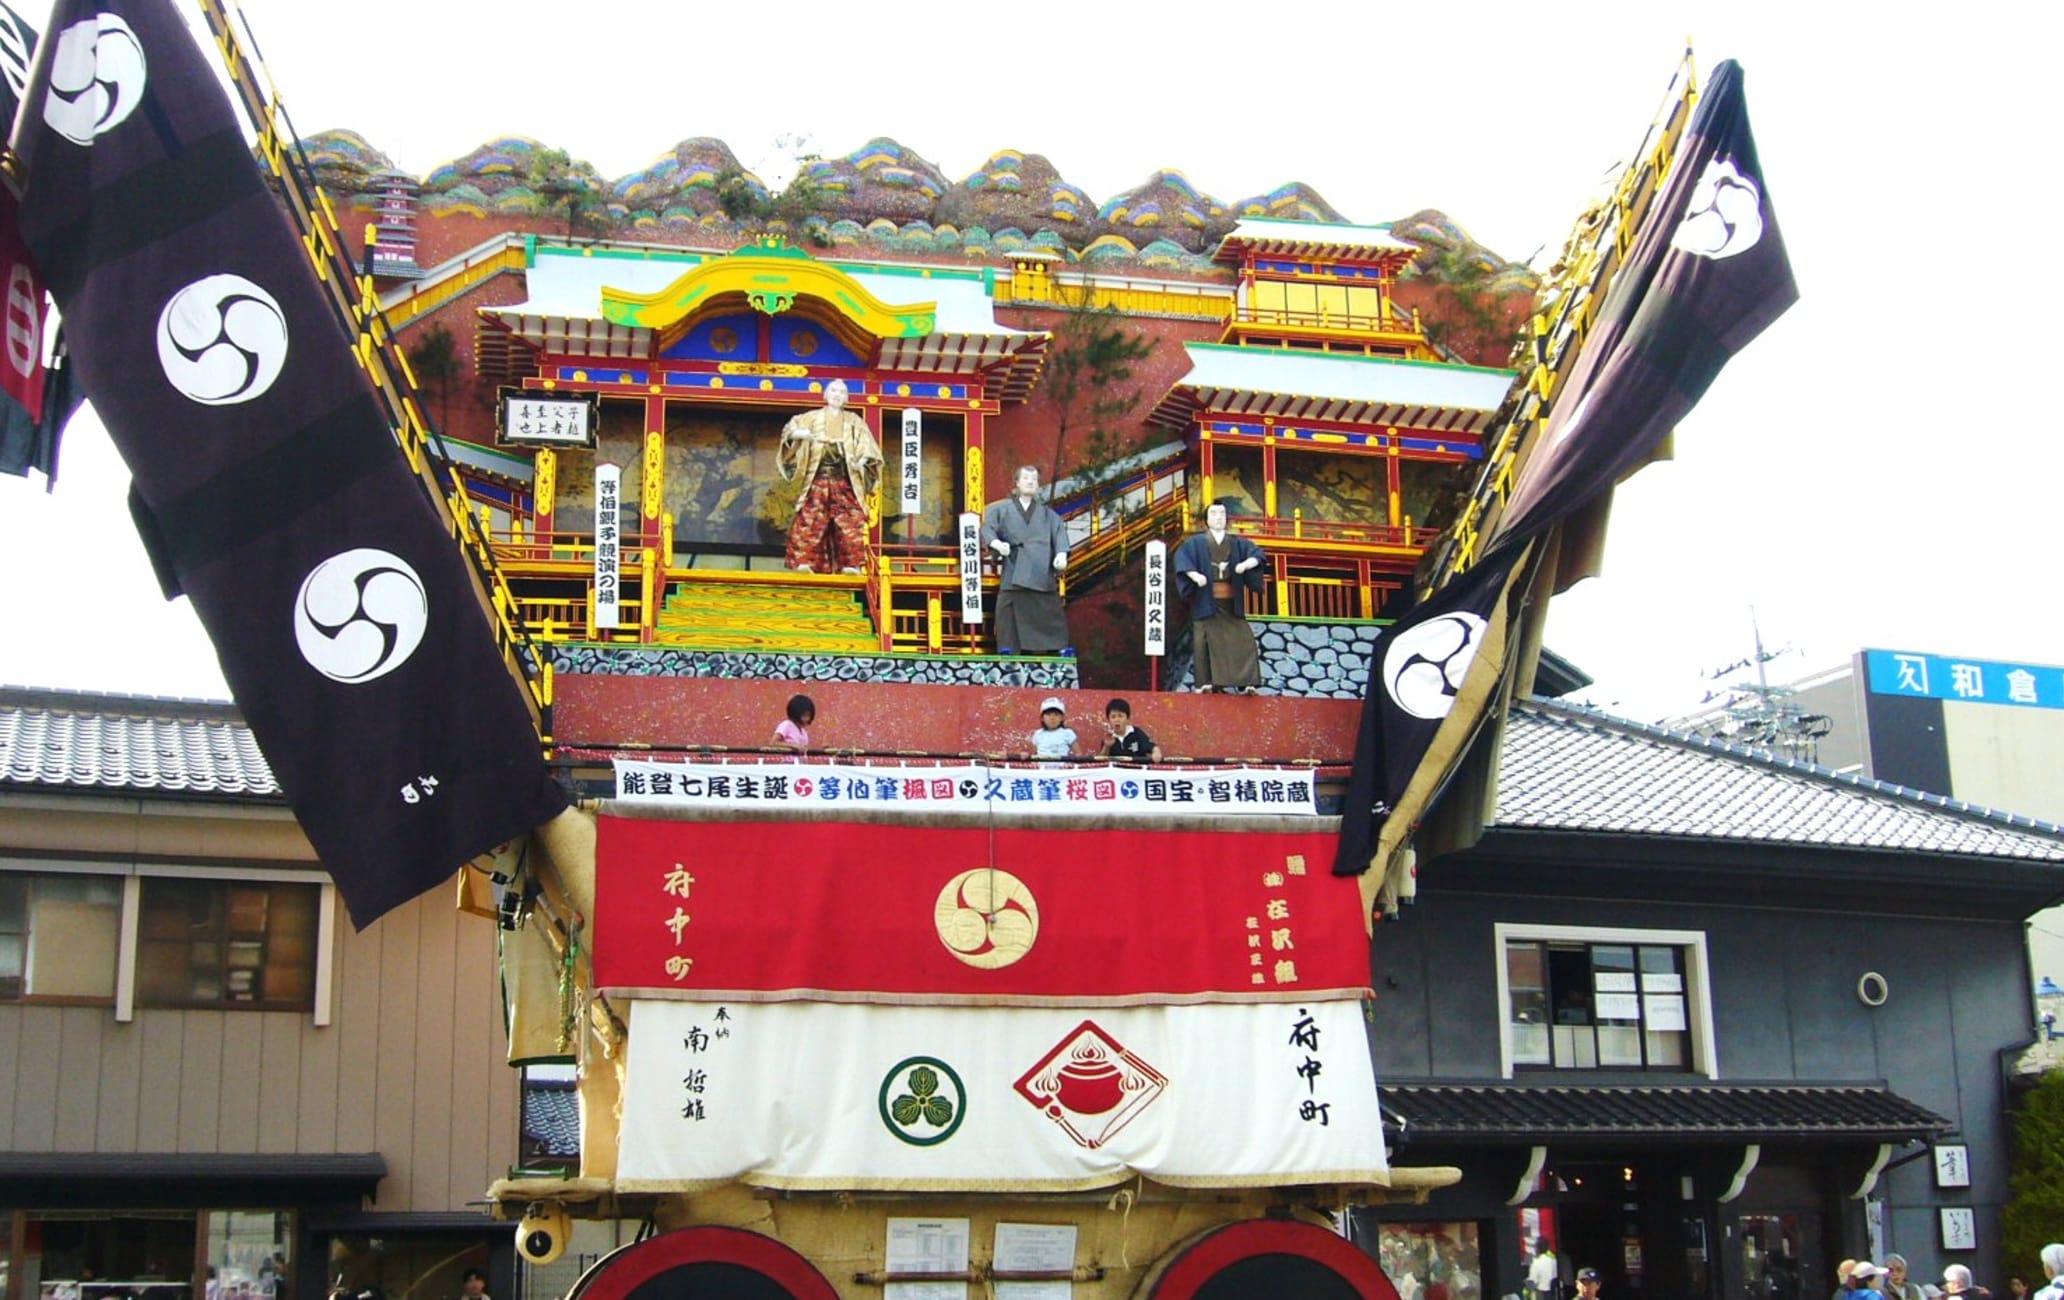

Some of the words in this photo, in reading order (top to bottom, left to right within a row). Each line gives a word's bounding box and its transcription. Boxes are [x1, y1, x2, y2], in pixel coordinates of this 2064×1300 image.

[903, 419, 919, 502] 豊臣秀吉
[597, 479, 617, 605] 等伯親子競演の場
[963, 524, 980, 610] 長谷川等伯
[1148, 554, 1163, 642] 長谷川久蔵
[1952, 664, 2064, 705] 和倉
[622, 772, 789, 800] 能登七尾生誕
[818, 776, 955, 801] 等伯筆楓図
[983, 778, 1116, 803] 久蔵筆桜図
[663, 863, 696, 981] 府中町
[1288, 1008, 1331, 1127] 府中町
